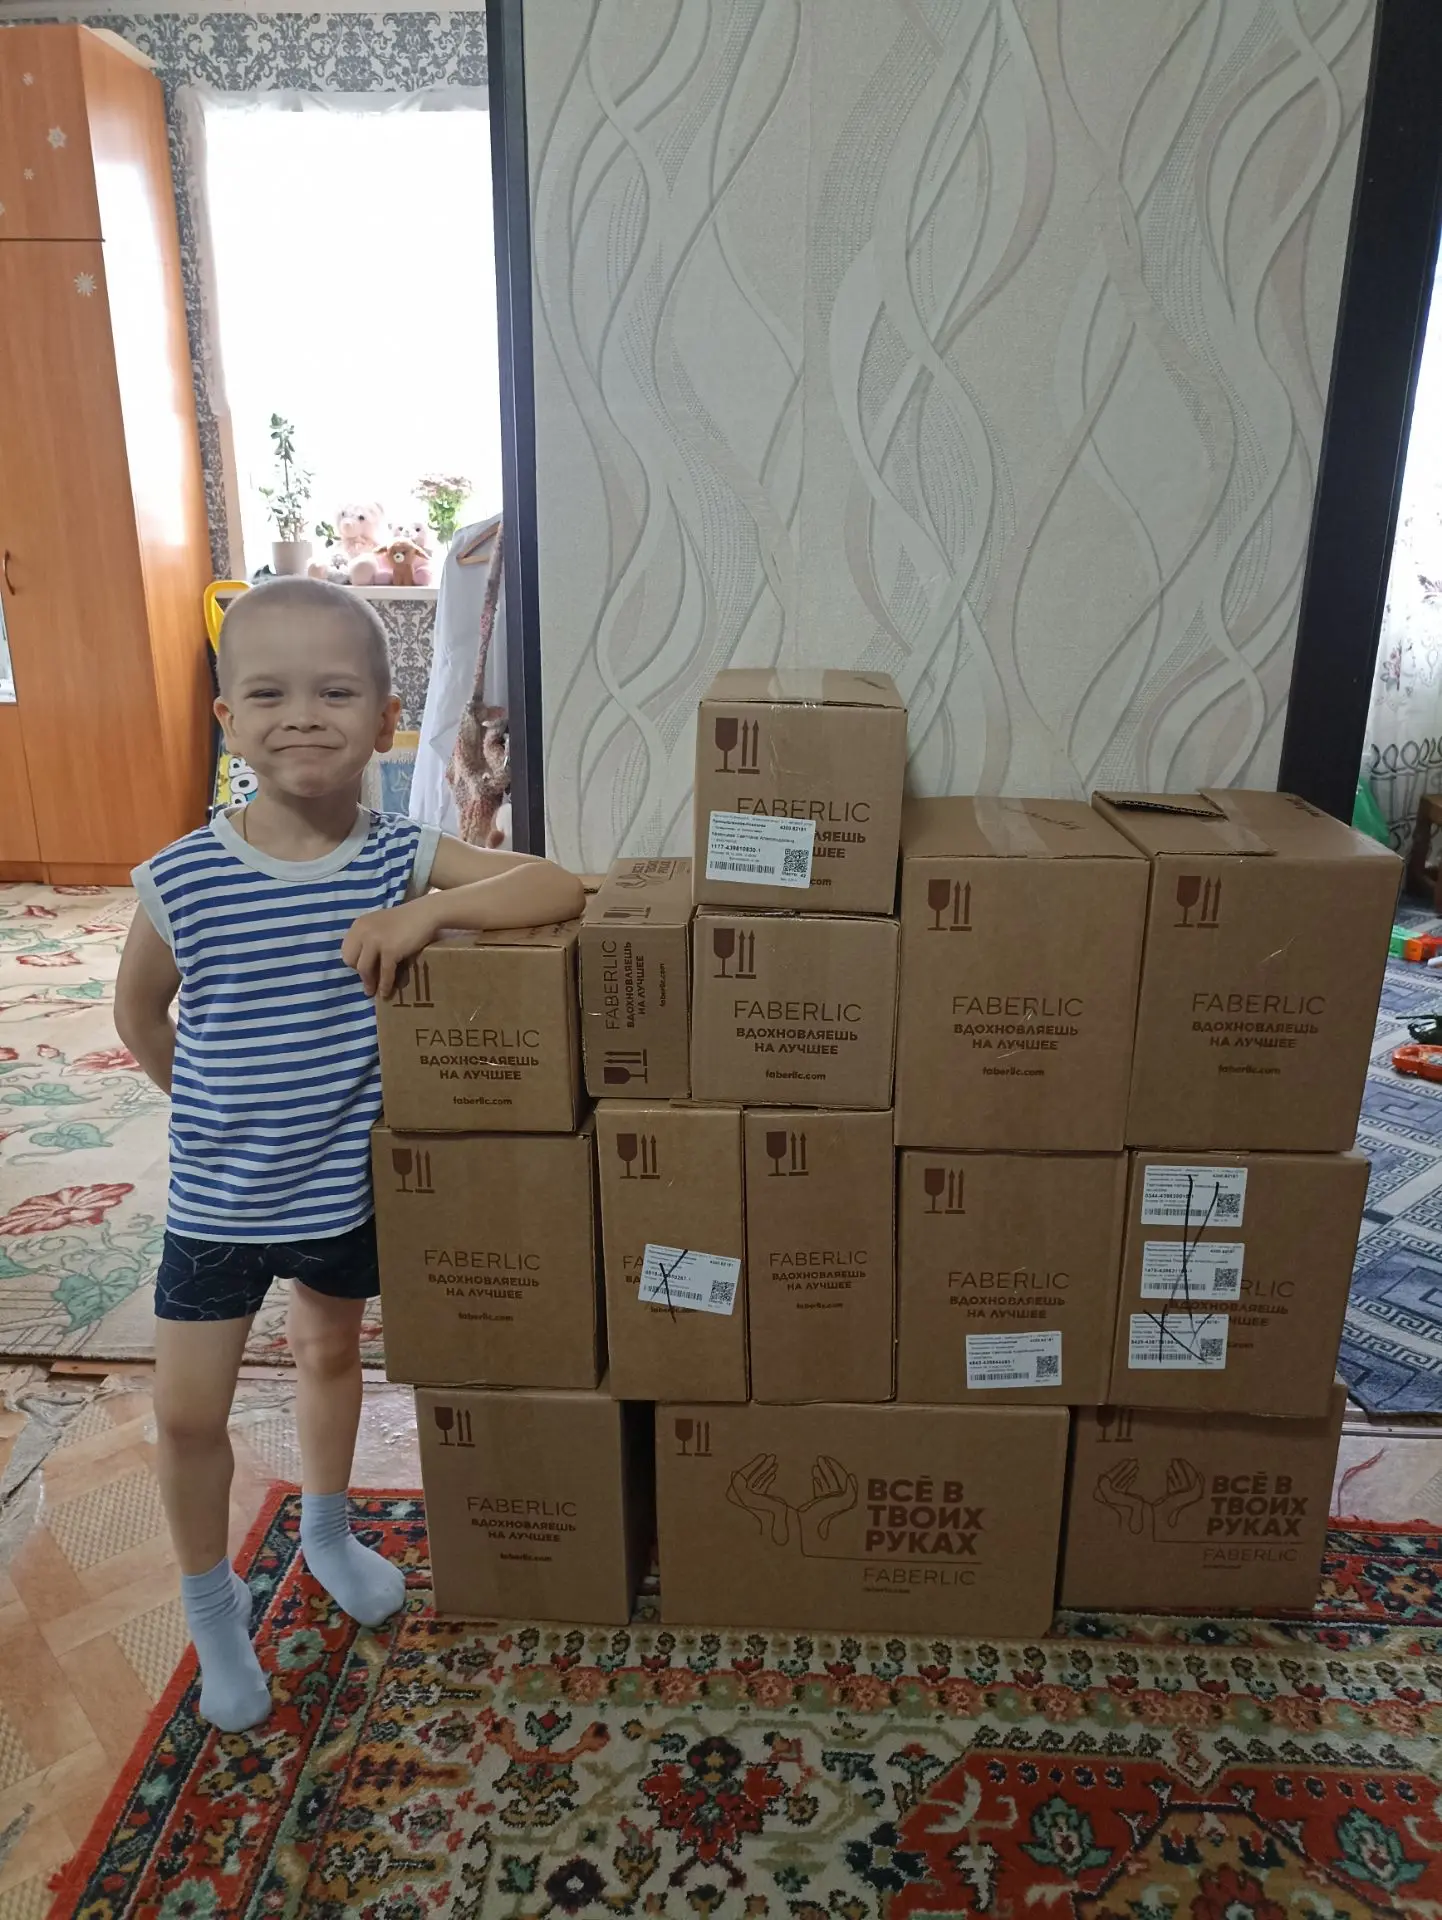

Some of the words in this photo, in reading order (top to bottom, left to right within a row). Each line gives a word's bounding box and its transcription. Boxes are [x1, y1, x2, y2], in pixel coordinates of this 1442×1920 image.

[737, 797, 871, 823] FABERLIC
[812, 846, 846, 859] ШЕЕ
[636, 955, 646, 998] ЛУЧШЕЕ
[602, 940, 620, 1030] FABERLIC
[624, 941, 635, 1029] ВДОХНОВЛЯЕШЬ
[638, 1001, 646, 1015] НА
[734, 1000, 862, 1022] FABERLIC
[952, 996, 1084, 1017] FABERLIC
[1192, 993, 1326, 1015] FABERLIC
[736, 1027, 858, 1041] ВДОХНОВЛЯЕШЬ
[954, 1023, 1079, 1036] ВДОХНОВЛЯЕШЬ
[1192, 1021, 1319, 1034] ВДОХНОВЛЯЕШЬ
[415, 1028, 540, 1048] FABERLIC
[972, 1039, 993, 1049] НА
[997, 1040, 1059, 1050] ЛУЧШЕЕ
[1210, 1036, 1230, 1047] НА
[1235, 1037, 1298, 1048] ЛУЧШЕЕ
[754, 1042, 775, 1053] НА
[778, 1043, 838, 1055] ЛУЧШЕЕ
[420, 1055, 539, 1066] ВДОХНОВЛЯЕШЬ
[440, 1070, 461, 1080] НА
[463, 1070, 522, 1080] ЛУЧШЕЕ
[765, 1070, 826, 1081] faberlic.com
[982, 1066, 1045, 1076] faberlic.com
[453, 1096, 512, 1105] faberlic.com
[424, 1249, 541, 1271] FABERLIC
[769, 1250, 868, 1267] FABERLIC
[428, 1273, 540, 1287] ВДОХНОВЛЯЕШЬ
[772, 1270, 866, 1282] ВДОХНОВЛЯЕШЬ
[947, 1271, 1070, 1289] FABERLIC
[446, 1287, 465, 1297] НА
[469, 1288, 523, 1299] ЛУЧШЕЕ
[787, 1283, 802, 1292] НА
[806, 1281, 852, 1290] ЛУЧШЕЕ
[1241, 1279, 1295, 1297] RLIC
[950, 1296, 1066, 1307] ВДОХНОВЛЯЕШЬ
[967, 1309, 985, 1318] НА
[990, 1309, 1047, 1319] ЛУЧШЕЕ
[943, 1480, 964, 1503] В
[1274, 1475, 1293, 1495] В
[466, 1497, 577, 1517] FABERLIC
[1210, 1496, 1309, 1516] ТВОИХ
[866, 1504, 985, 1530] ТВОИХ
[471, 1518, 576, 1531] ВДОХНОВЛЯЕШЬ
[1206, 1517, 1302, 1537] РУКАХ
[488, 1531, 505, 1540] НА
[509, 1531, 561, 1542] ЛУЧШЕЕ
[865, 1529, 977, 1556] РУКАХ
[1203, 1548, 1298, 1561] FABERLIC
[863, 1567, 976, 1586] FABERLIC
